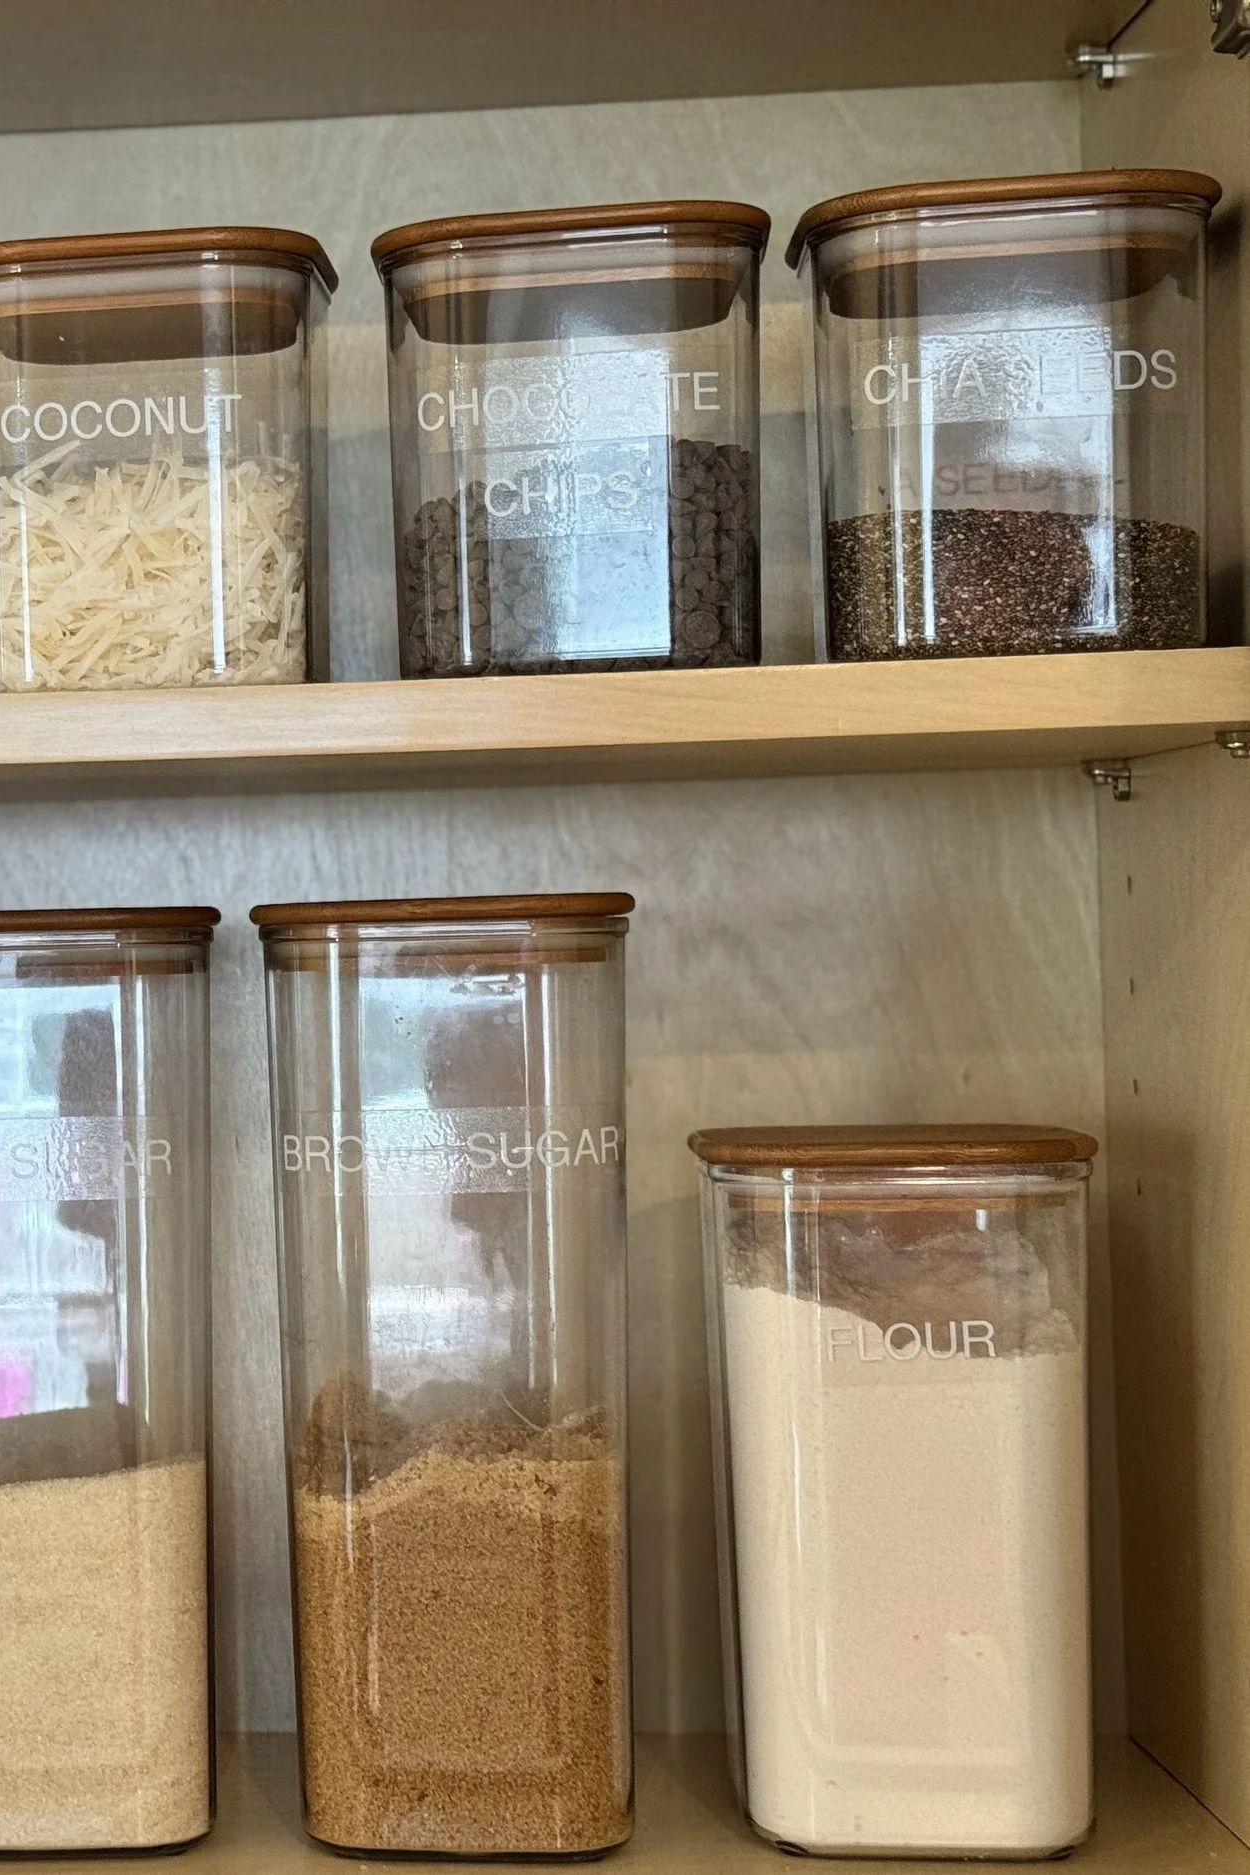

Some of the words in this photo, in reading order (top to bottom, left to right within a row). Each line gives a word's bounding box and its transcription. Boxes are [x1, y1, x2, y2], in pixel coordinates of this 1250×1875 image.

[863, 357, 989, 405] CHIA
[1004, 348, 1178, 397] EEDS
[0, 394, 243, 444] COCONUT
[417, 371, 721, 432] CHOCOATE
[483, 470, 639, 518] CHIPS
[282, 1134, 452, 1173] BROW
[467, 1126, 620, 1169] SUGAR
[827, 1319, 997, 1363] FLOUR
